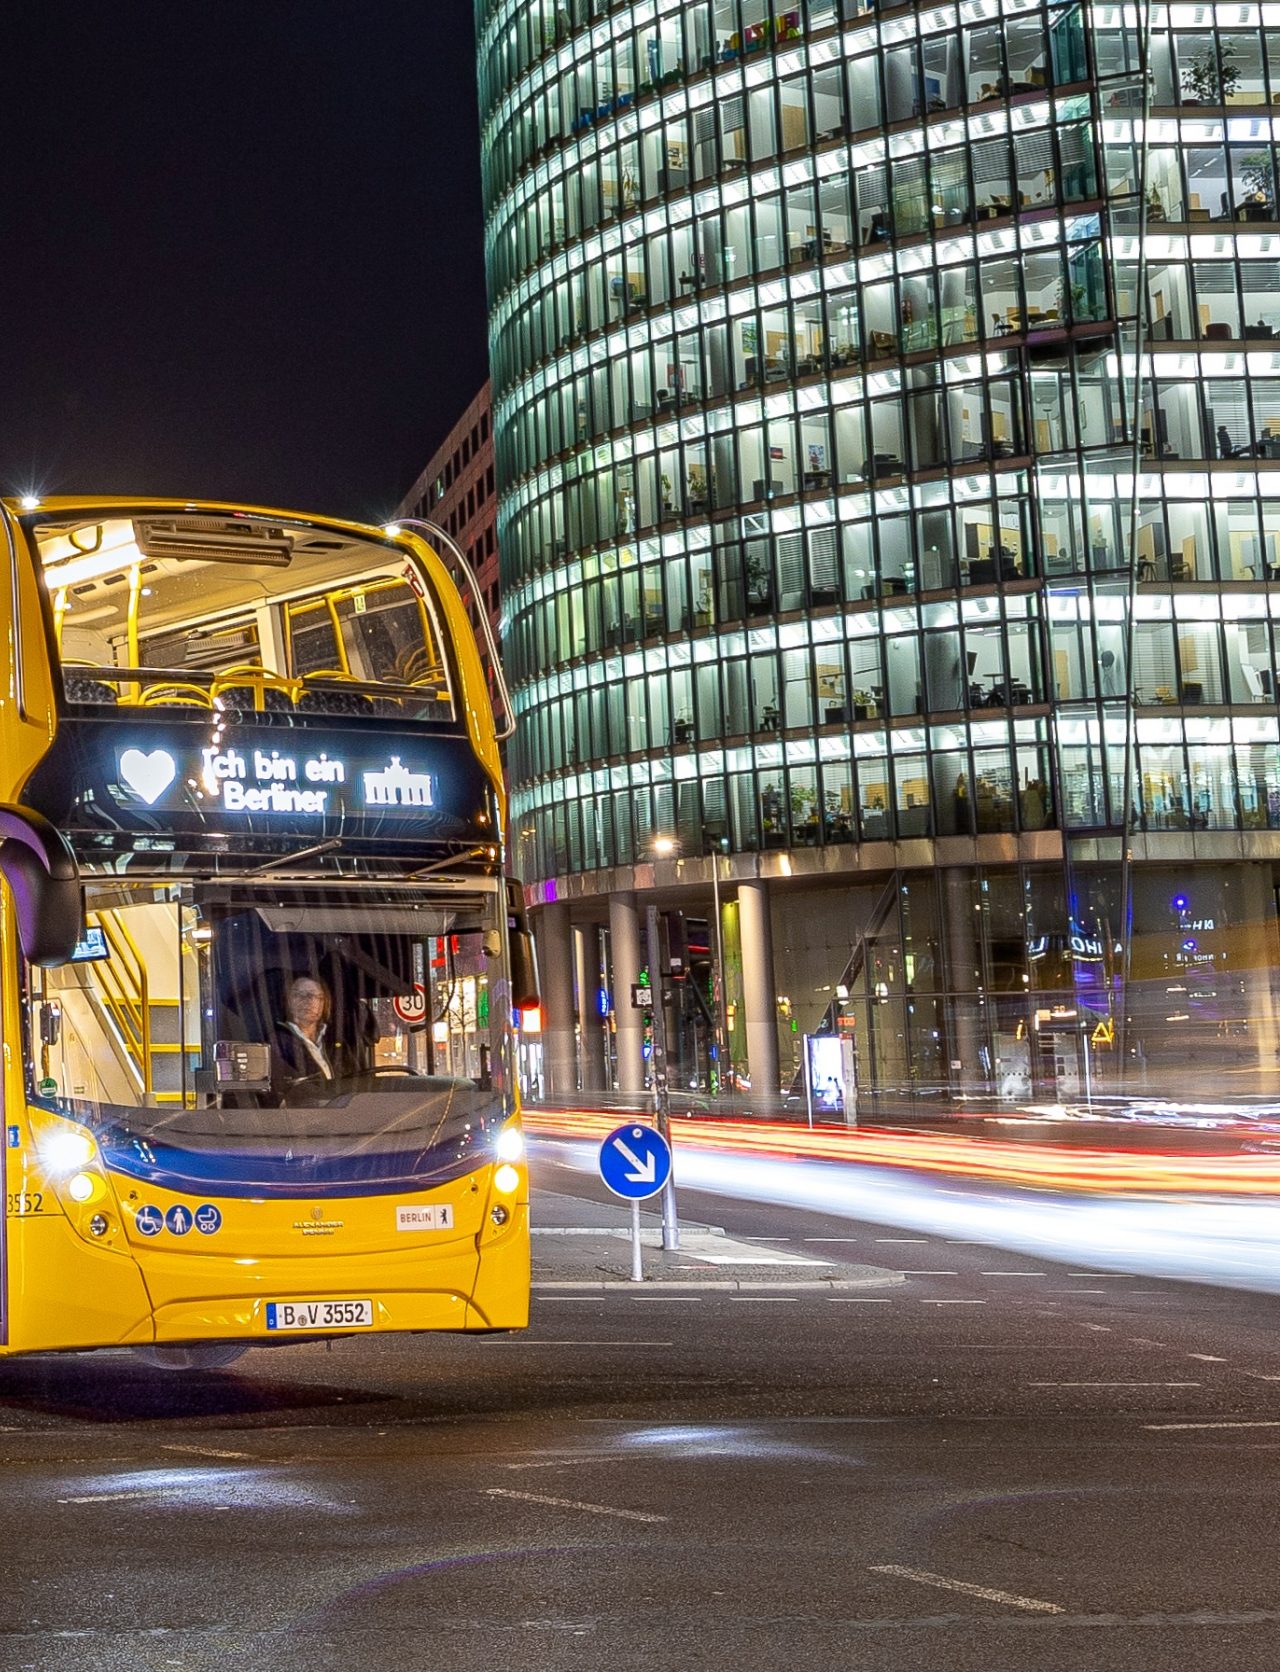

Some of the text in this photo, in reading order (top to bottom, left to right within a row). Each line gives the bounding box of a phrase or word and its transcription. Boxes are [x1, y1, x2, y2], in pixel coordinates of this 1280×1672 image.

[203, 748, 345, 782] Ich bin ein
[223, 780, 328, 813] Berliner
[403, 995, 423, 1011] 30
[8, 1193, 43, 1213] 3552
[400, 1213, 432, 1223] BERLIN
[283, 1303, 365, 1325] B V 3552
